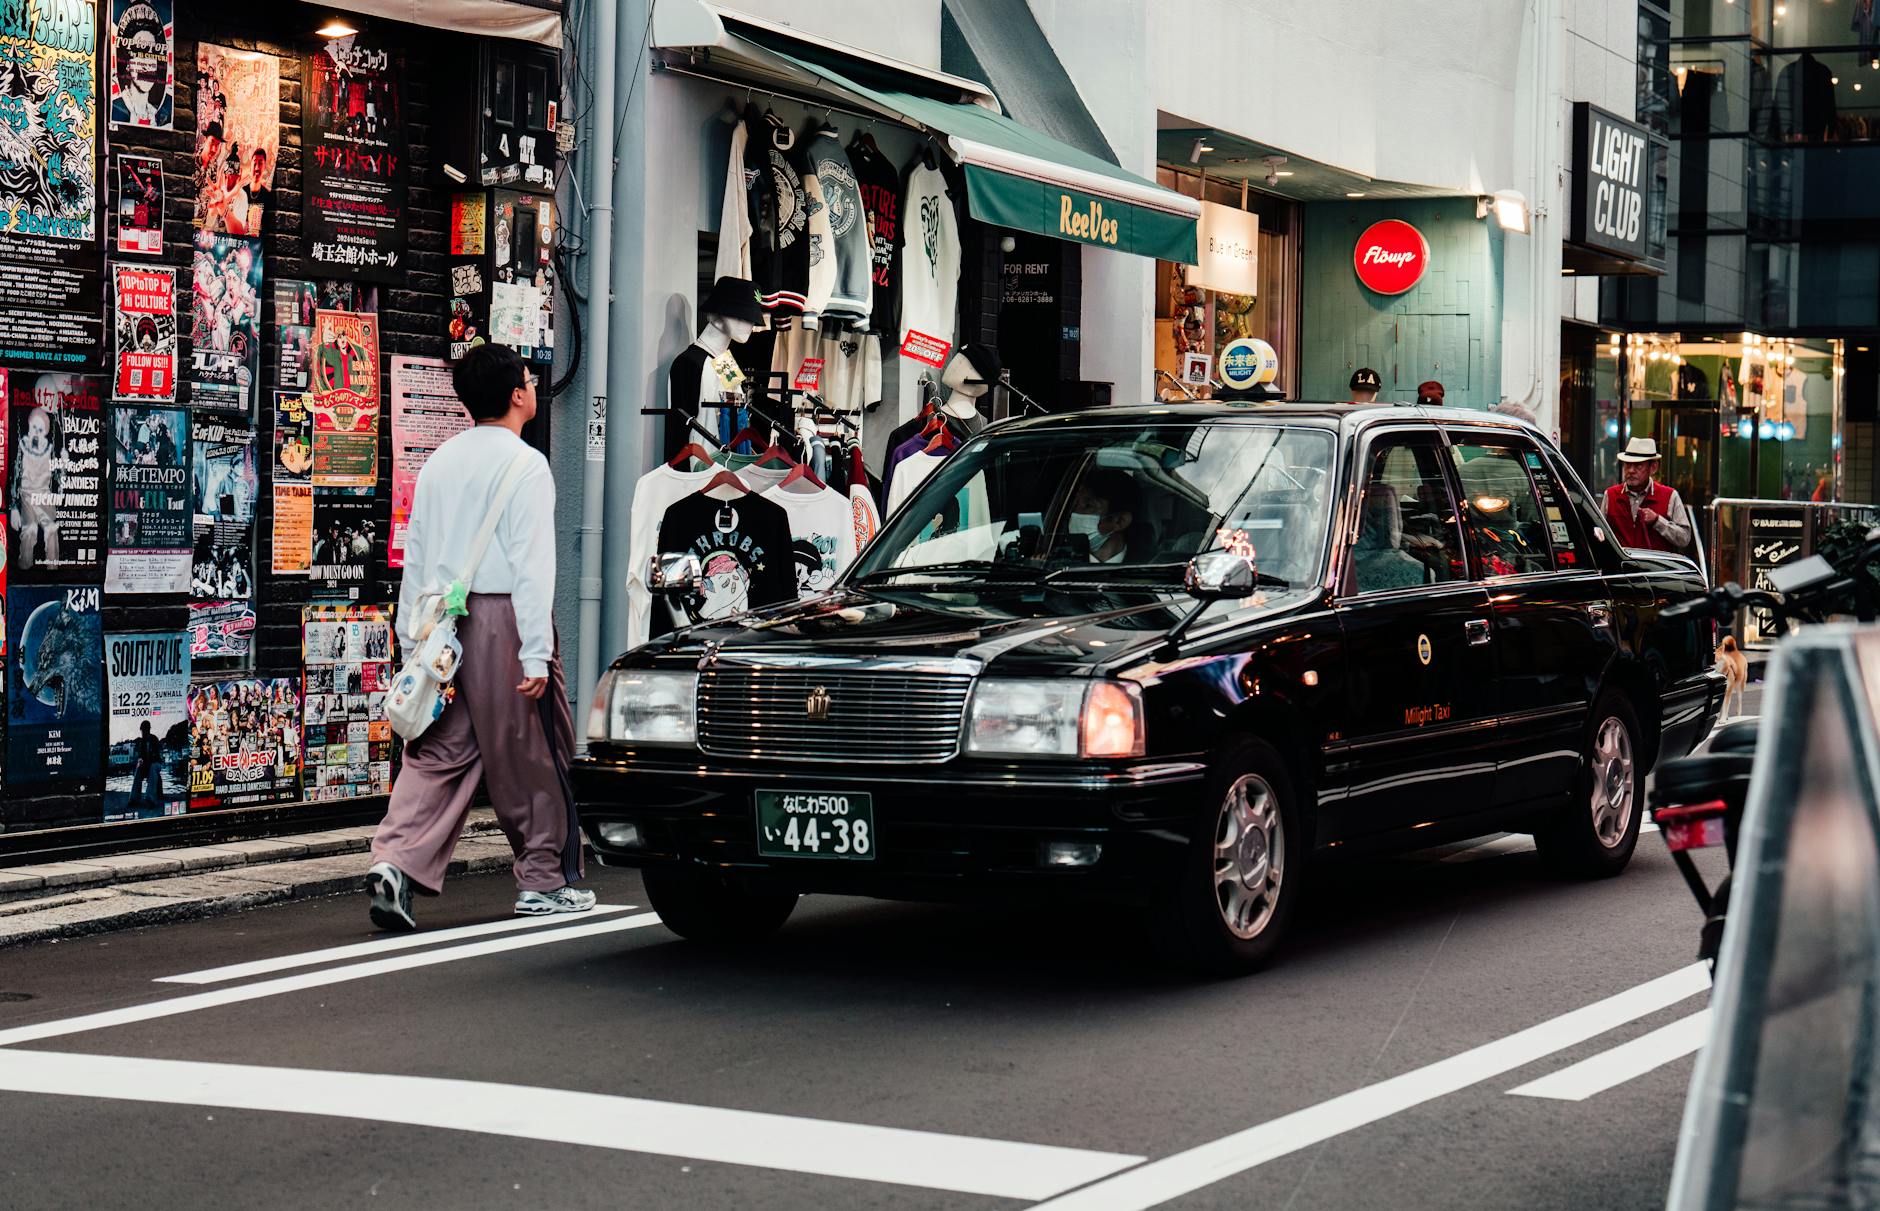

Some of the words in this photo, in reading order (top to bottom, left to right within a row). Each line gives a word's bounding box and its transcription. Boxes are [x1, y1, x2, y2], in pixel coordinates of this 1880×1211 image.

[313, 145, 398, 177] サリドマイド
[1591, 120, 1645, 188] LIGHT
[1594, 180, 1642, 243] CLUB
[1059, 194, 1119, 246] ReeVes
[311, 242, 398, 268] 埼玉会館小ホール
[1003, 264, 1022, 274] FOR
[1024, 264, 1050, 275] RENT
[161, 278, 171, 295] by
[124, 294, 133, 308] Hi
[134, 295, 169, 310] CULTURE
[5, 350, 35, 359] SUMMER
[35, 351, 53, 361] DAYZ
[53, 353, 62, 361] AT
[62, 354, 86, 362] STOMP
[126, 355, 152, 368] FOLLOW
[153, 356, 168, 369] US!!!
[1225, 354, 1258, 368] 未来都
[1228, 369, 1252, 377] MILIGHT
[63, 415, 100, 435] BALZAC
[207, 424, 225, 443] KID
[60, 476, 99, 490] SANDIEST
[275, 486, 291, 497] TIME
[292, 486, 312, 497] TABLE
[64, 493, 99, 507] JUNKIES
[167, 497, 185, 511] Tour
[322, 565, 341, 580] MUST
[341, 565, 353, 580] GO
[352, 565, 364, 580] ON
[65, 588, 100, 612] KiM
[112, 640, 154, 677] SOUTH
[155, 639, 183, 675] BLUE
[118, 691, 151, 707] 12.22
[155, 690, 183, 699] SUNHALL
[1405, 705, 1432, 727] Milight
[1433, 702, 1450, 720] Taxi
[48, 730, 61, 738] KiM
[192, 770, 214, 785] 11.09
[226, 767, 265, 781] DANCE
[764, 825, 781, 841] い
[783, 816, 870, 854] 44-38
